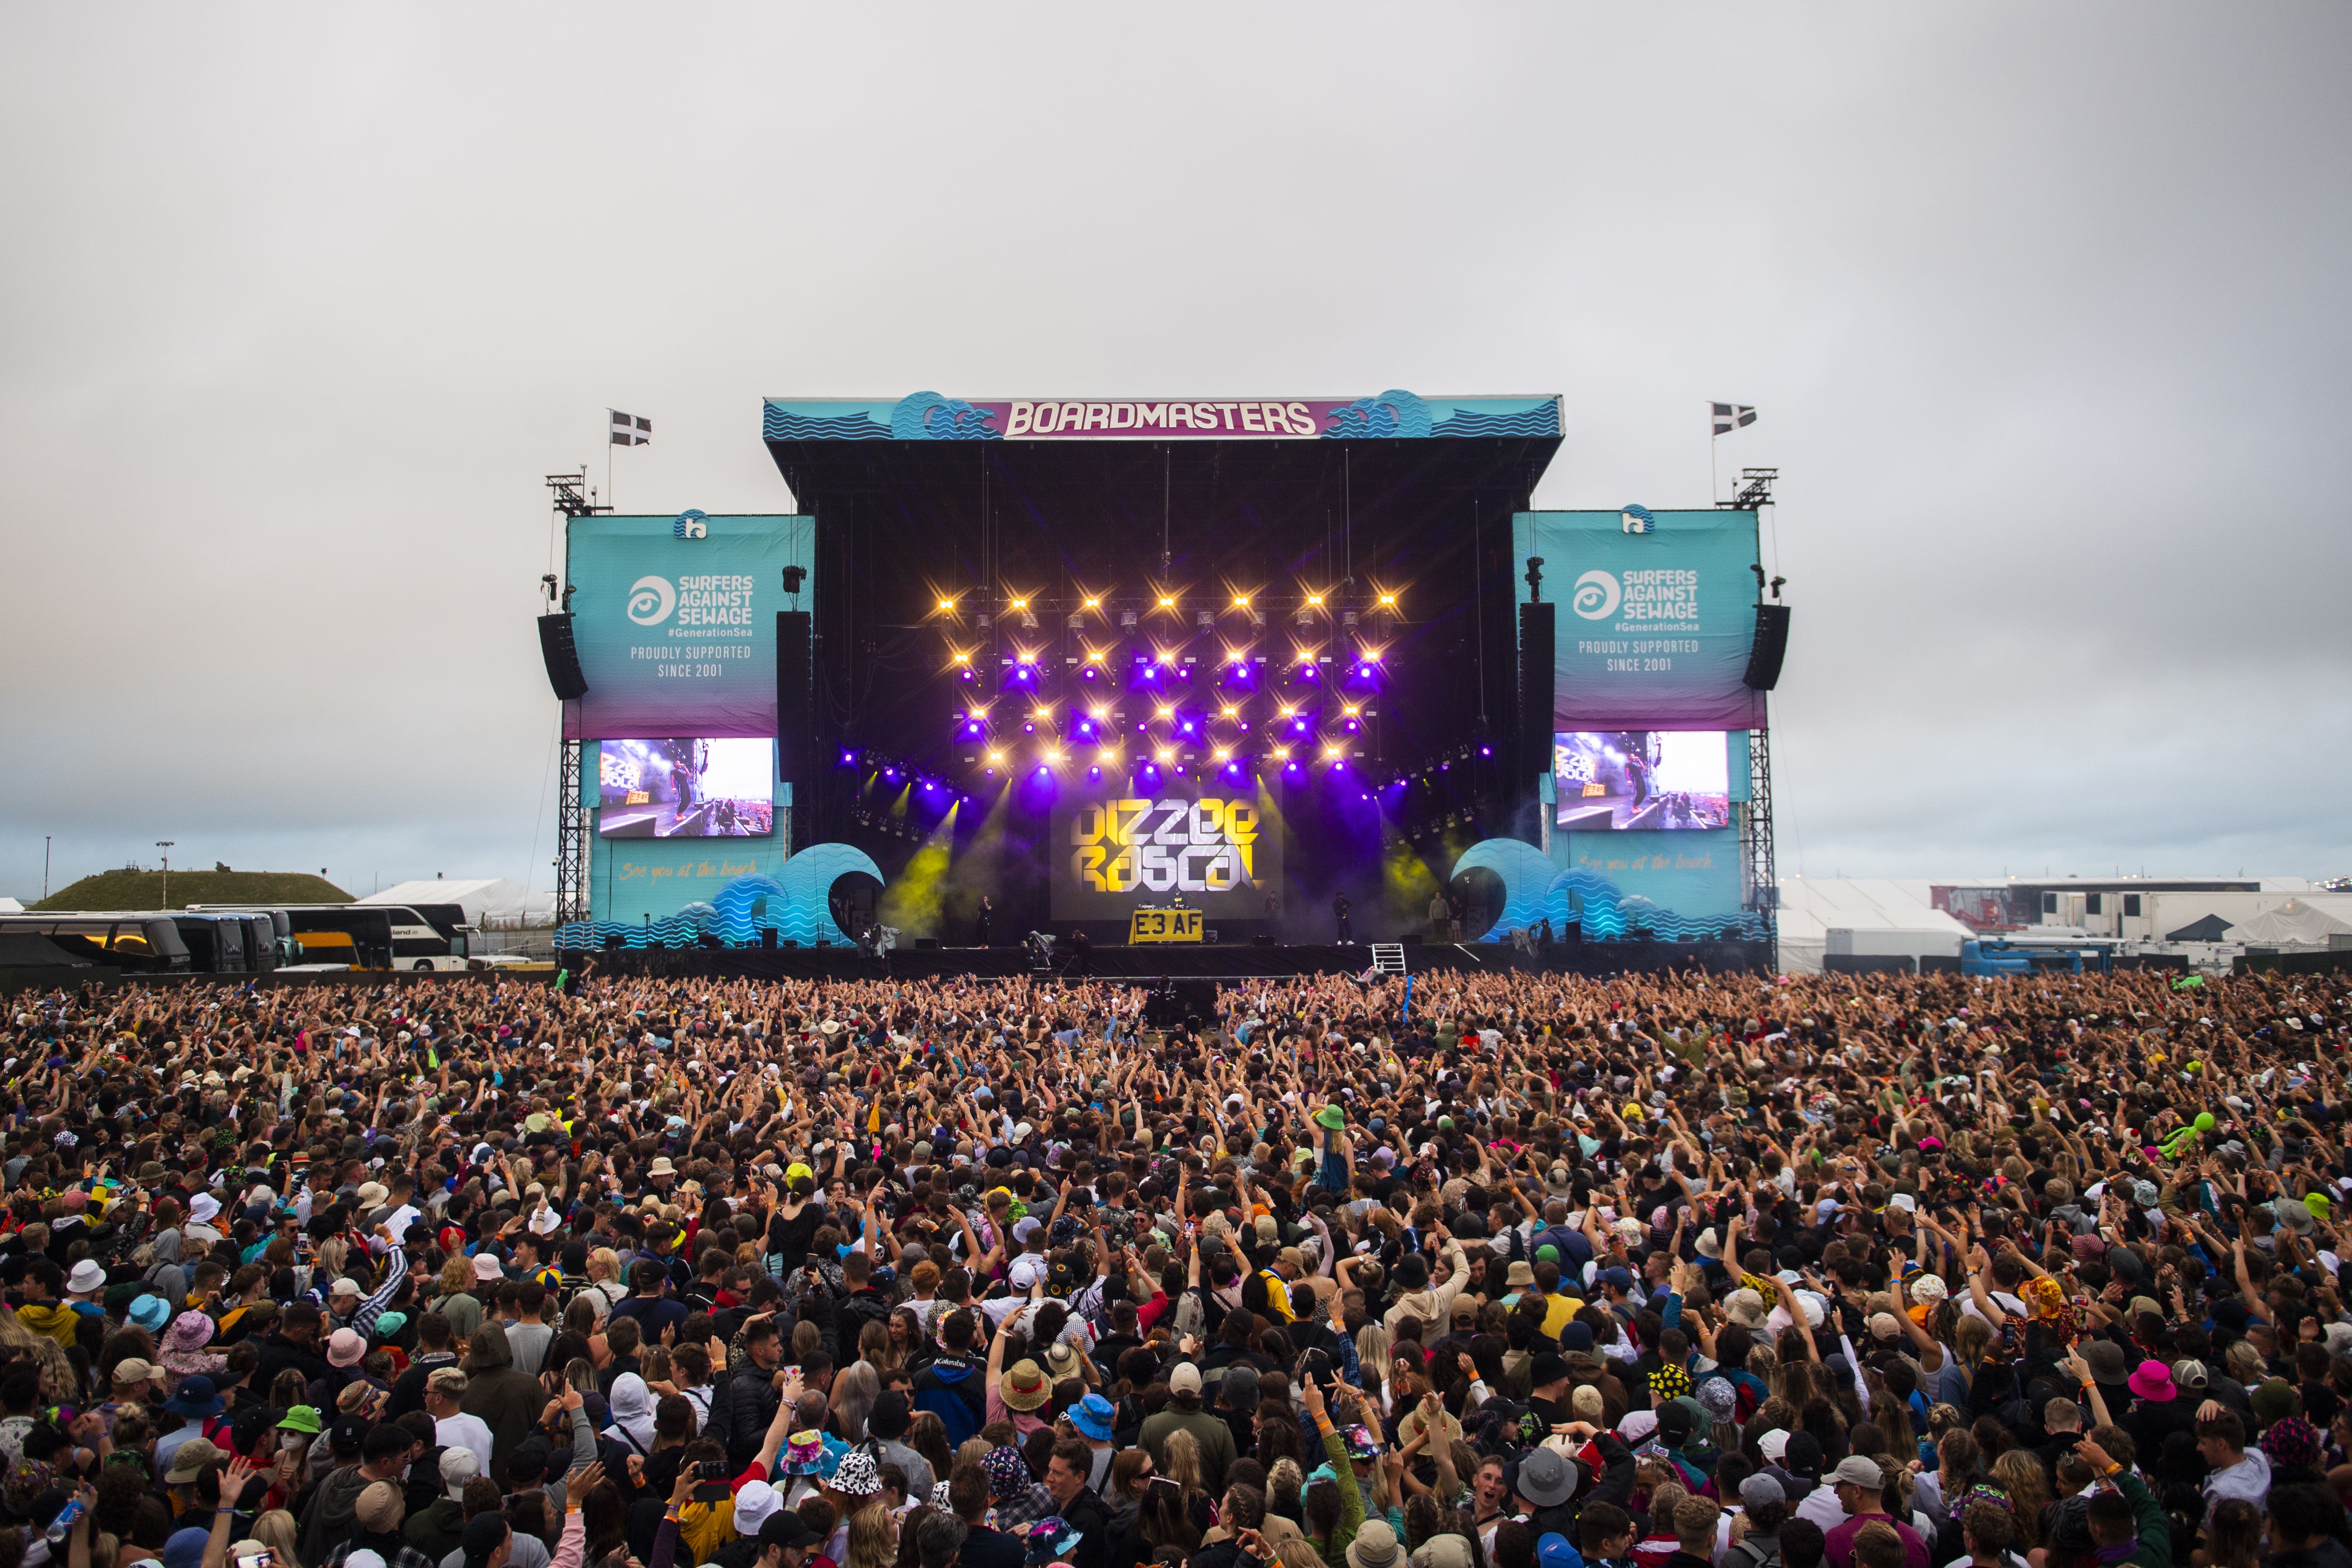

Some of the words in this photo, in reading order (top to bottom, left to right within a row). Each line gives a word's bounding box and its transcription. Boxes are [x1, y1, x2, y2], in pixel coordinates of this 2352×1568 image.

[1004, 401, 1317, 436] BOARDMASTERS
[679, 575, 753, 591] SURFERS
[1623, 570, 1697, 586] SURFERS
[679, 591, 753, 607] AGAINST
[1623, 585, 1698, 602] AGAINST
[678, 608, 752, 625] SEWAGE
[1624, 602, 1698, 619] SEWAGE
[668, 627, 753, 637] #GenerationSea
[1615, 622, 1700, 632] #GenerationSea
[631, 647, 681, 659] PROUDLY
[685, 646, 751, 659] SUPPORTED
[1579, 641, 1628, 654] PROUDLY
[1634, 641, 1699, 653] SUPPORTED
[658, 665, 691, 677] SINCE
[696, 664, 723, 677] 2001
[1607, 659, 1640, 671] SINCE
[1644, 659, 1671, 671] 2001
[619, 863, 647, 880] See
[651, 866, 673, 885] you
[677, 862, 694, 877] at
[697, 860, 717, 877] the
[1607, 859, 1628, 877] you
[1632, 855, 1648, 870] at
[1652, 853, 1671, 870] the
[1136, 913, 1165, 935] E3
[1173, 913, 1201, 934] AF
[938, 1357, 966, 1368] Columbia
